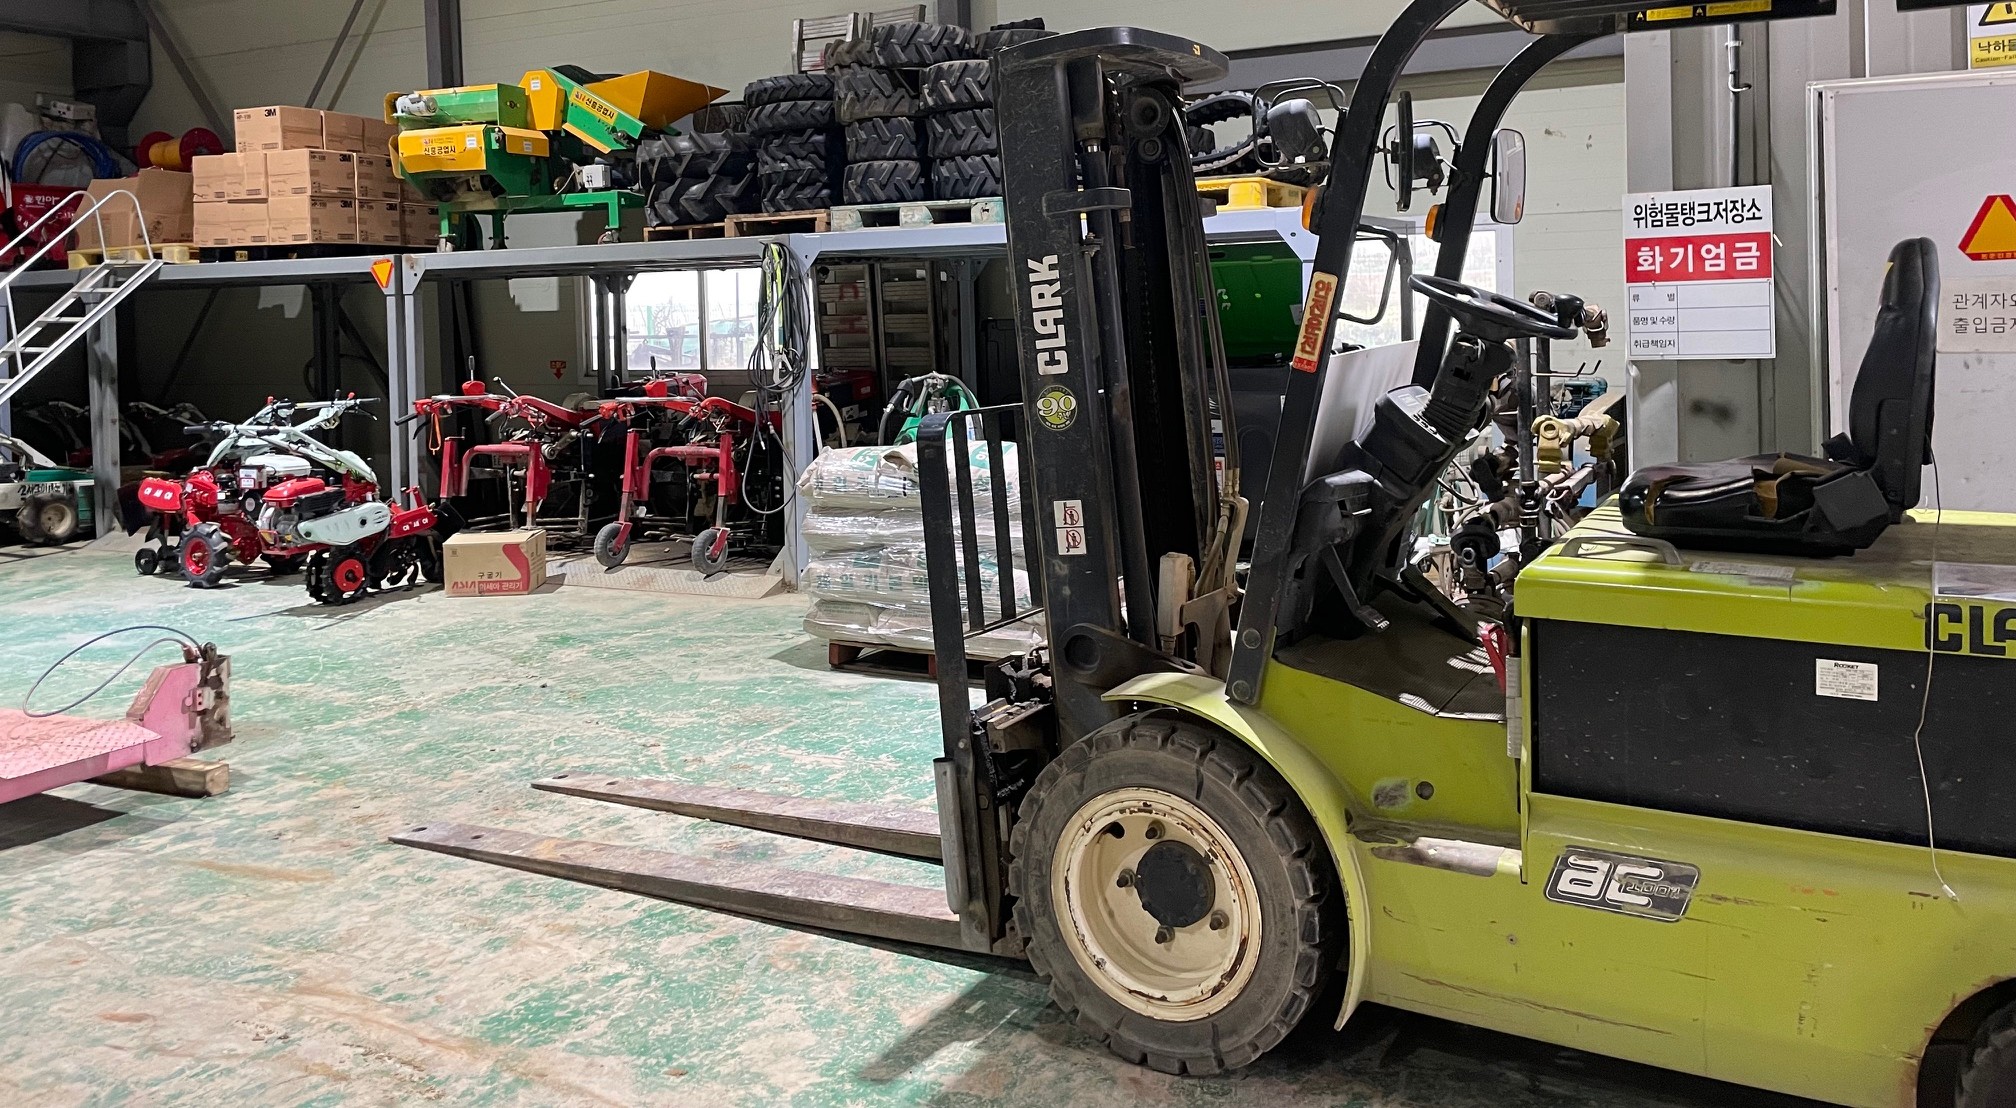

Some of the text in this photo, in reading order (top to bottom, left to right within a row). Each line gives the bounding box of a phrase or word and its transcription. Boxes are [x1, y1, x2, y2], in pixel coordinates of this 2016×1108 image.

[264, 108, 277, 117] 3M
[339, 154, 352, 162] 3M
[340, 200, 353, 208] 3M
[385, 203, 398, 211] 3M
[1633, 198, 1763, 228] 위험물탱크저장소
[1027, 254, 1068, 376] CLARK
[1632, 316, 1675, 325] 품명 및 수량
[1633, 339, 1676, 348] 취급책임자
[1036, 395, 1077, 417] 90
[451, 581, 477, 590] ASIA
[501, 581, 523, 591] 관리기
